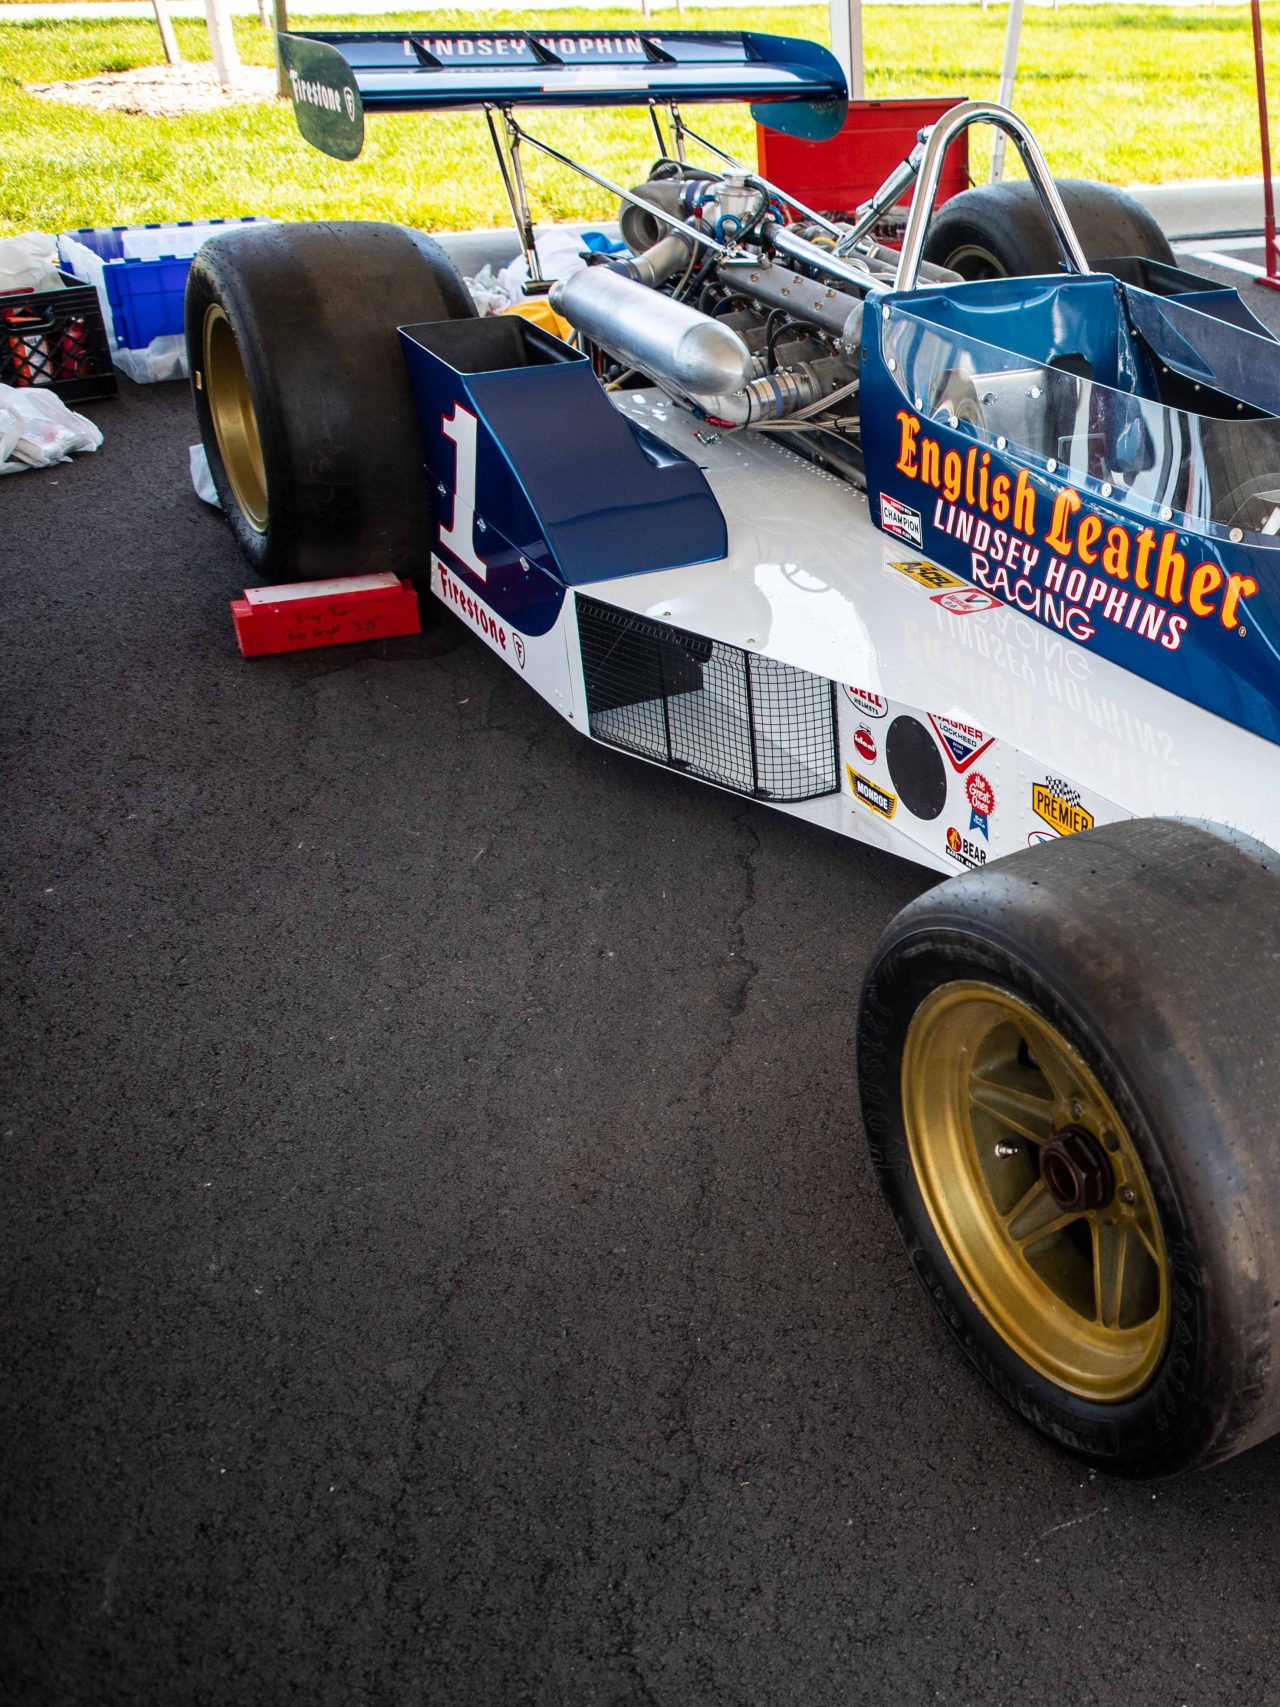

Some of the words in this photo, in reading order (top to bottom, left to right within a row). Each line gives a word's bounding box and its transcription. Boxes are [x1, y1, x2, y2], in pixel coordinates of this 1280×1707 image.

[403, 38, 526, 56] LINDSEY
[289, 68, 342, 113] Firestone
[440, 400, 488, 584] 1
[884, 507, 919, 533] CHAMPION
[895, 409, 1036, 538] English
[1043, 486, 1259, 631] Leather
[932, 497, 1040, 578] LINDSEY
[1044, 557, 1189, 652] HOPKINS
[438, 561, 507, 651] Firestone
[970, 551, 1096, 642] RACING
[853, 696, 879, 715] HELMETS
[933, 714, 983, 741] AGNER
[940, 723, 977, 748] LOCKHEED
[856, 780, 888, 811] MONROE
[969, 783, 991, 804] Great
[974, 775, 986, 791] the
[971, 796, 989, 814] Ones
[1037, 790, 1089, 833] PREMIER
[962, 838, 987, 865] BEAR
